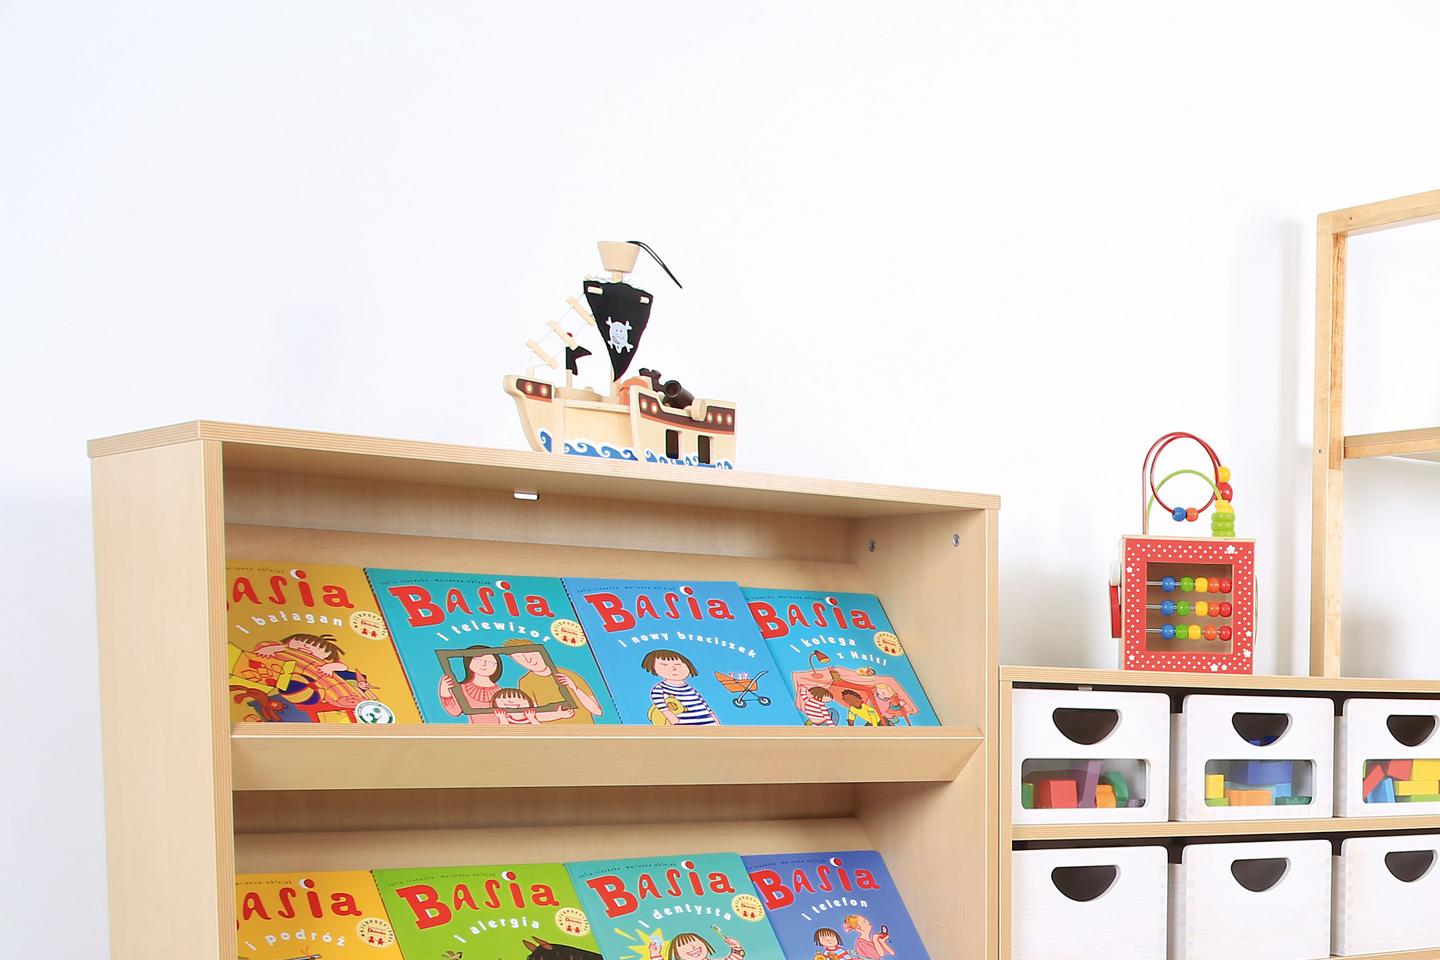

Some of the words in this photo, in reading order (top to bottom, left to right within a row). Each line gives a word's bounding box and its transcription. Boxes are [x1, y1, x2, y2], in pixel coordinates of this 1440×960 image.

[230, 569, 355, 610] asia
[451, 619, 551, 643] telewizor
[801, 634, 857, 648] kolega
[631, 631, 669, 644] nowy
[676, 630, 757, 659] braciszek
[239, 878, 362, 922] asia
[811, 896, 868, 914] telefon
[652, 903, 732, 921] dentysta
[469, 916, 540, 935] alergia
